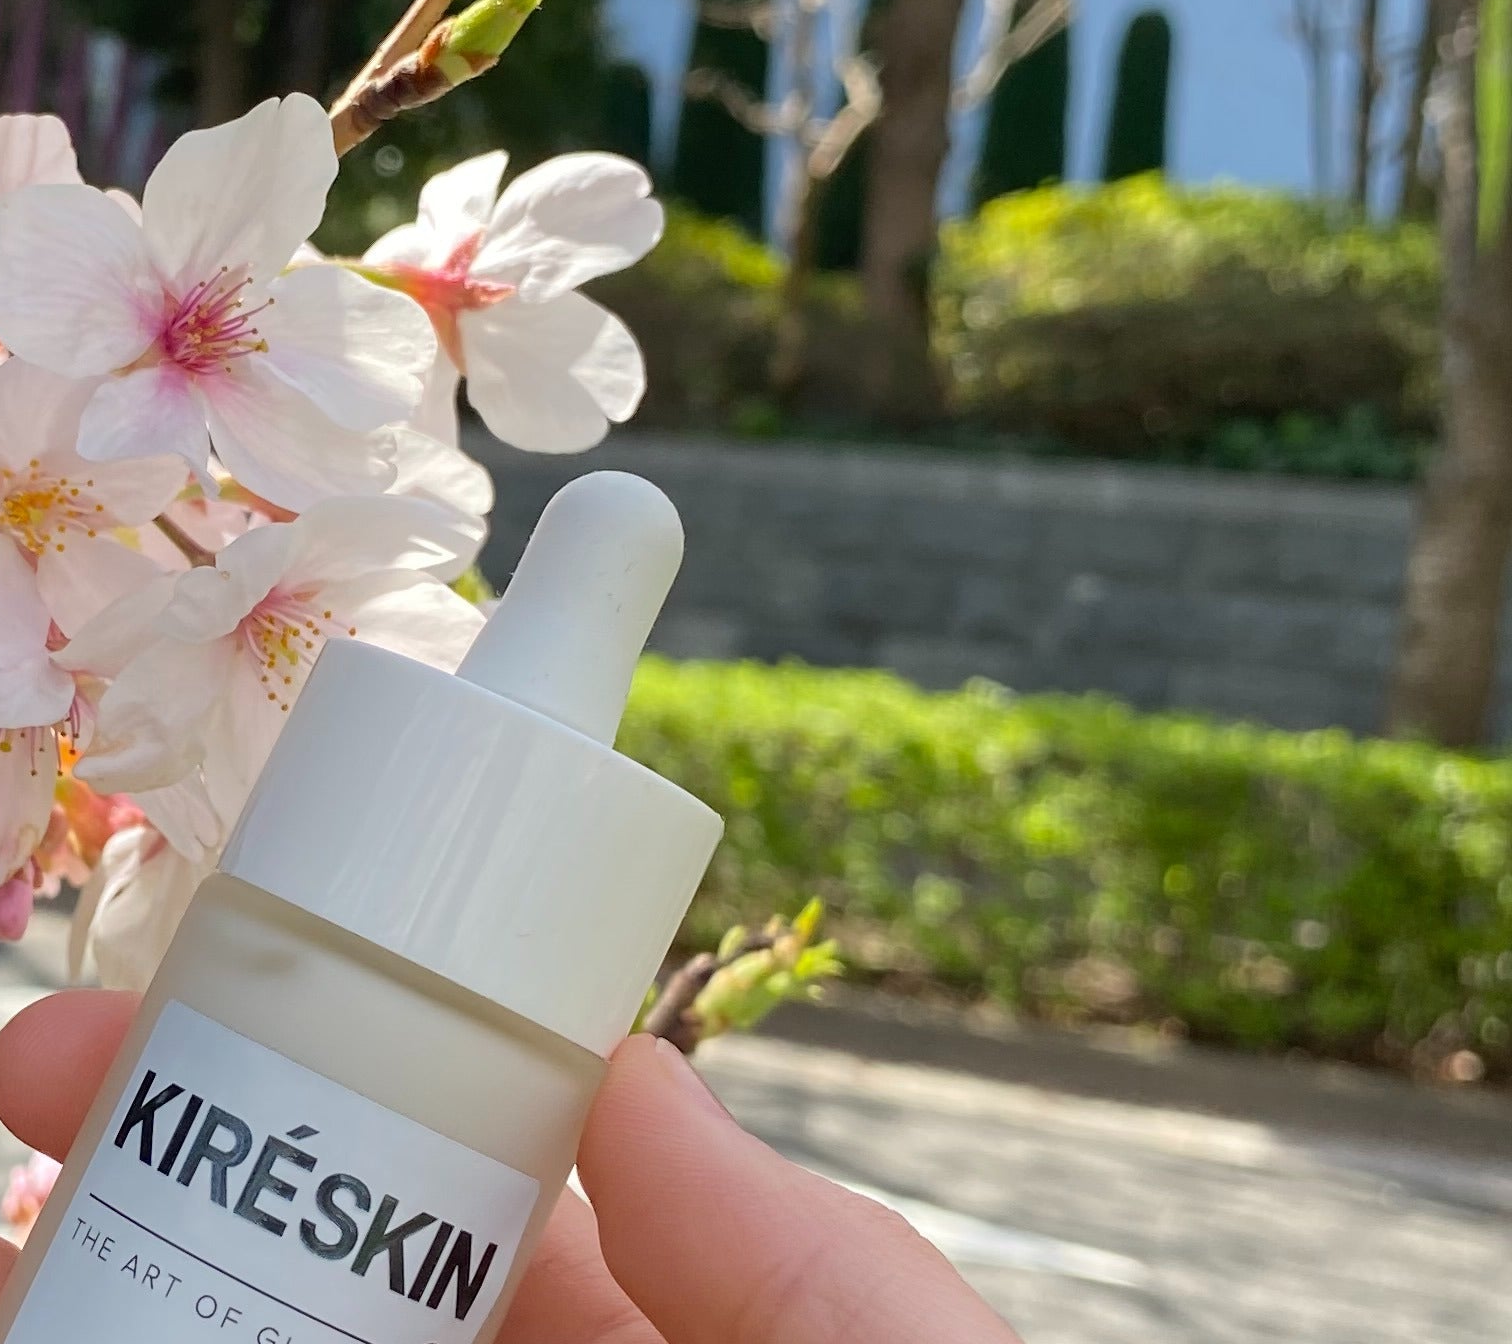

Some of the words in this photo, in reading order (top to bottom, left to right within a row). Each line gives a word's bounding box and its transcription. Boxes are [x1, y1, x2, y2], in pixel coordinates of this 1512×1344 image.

[72, 1218, 114, 1262] THE
[121, 1254, 182, 1299] ART
[196, 1294, 243, 1329] OF
[114, 1069, 499, 1321] KIRÉSKIN
